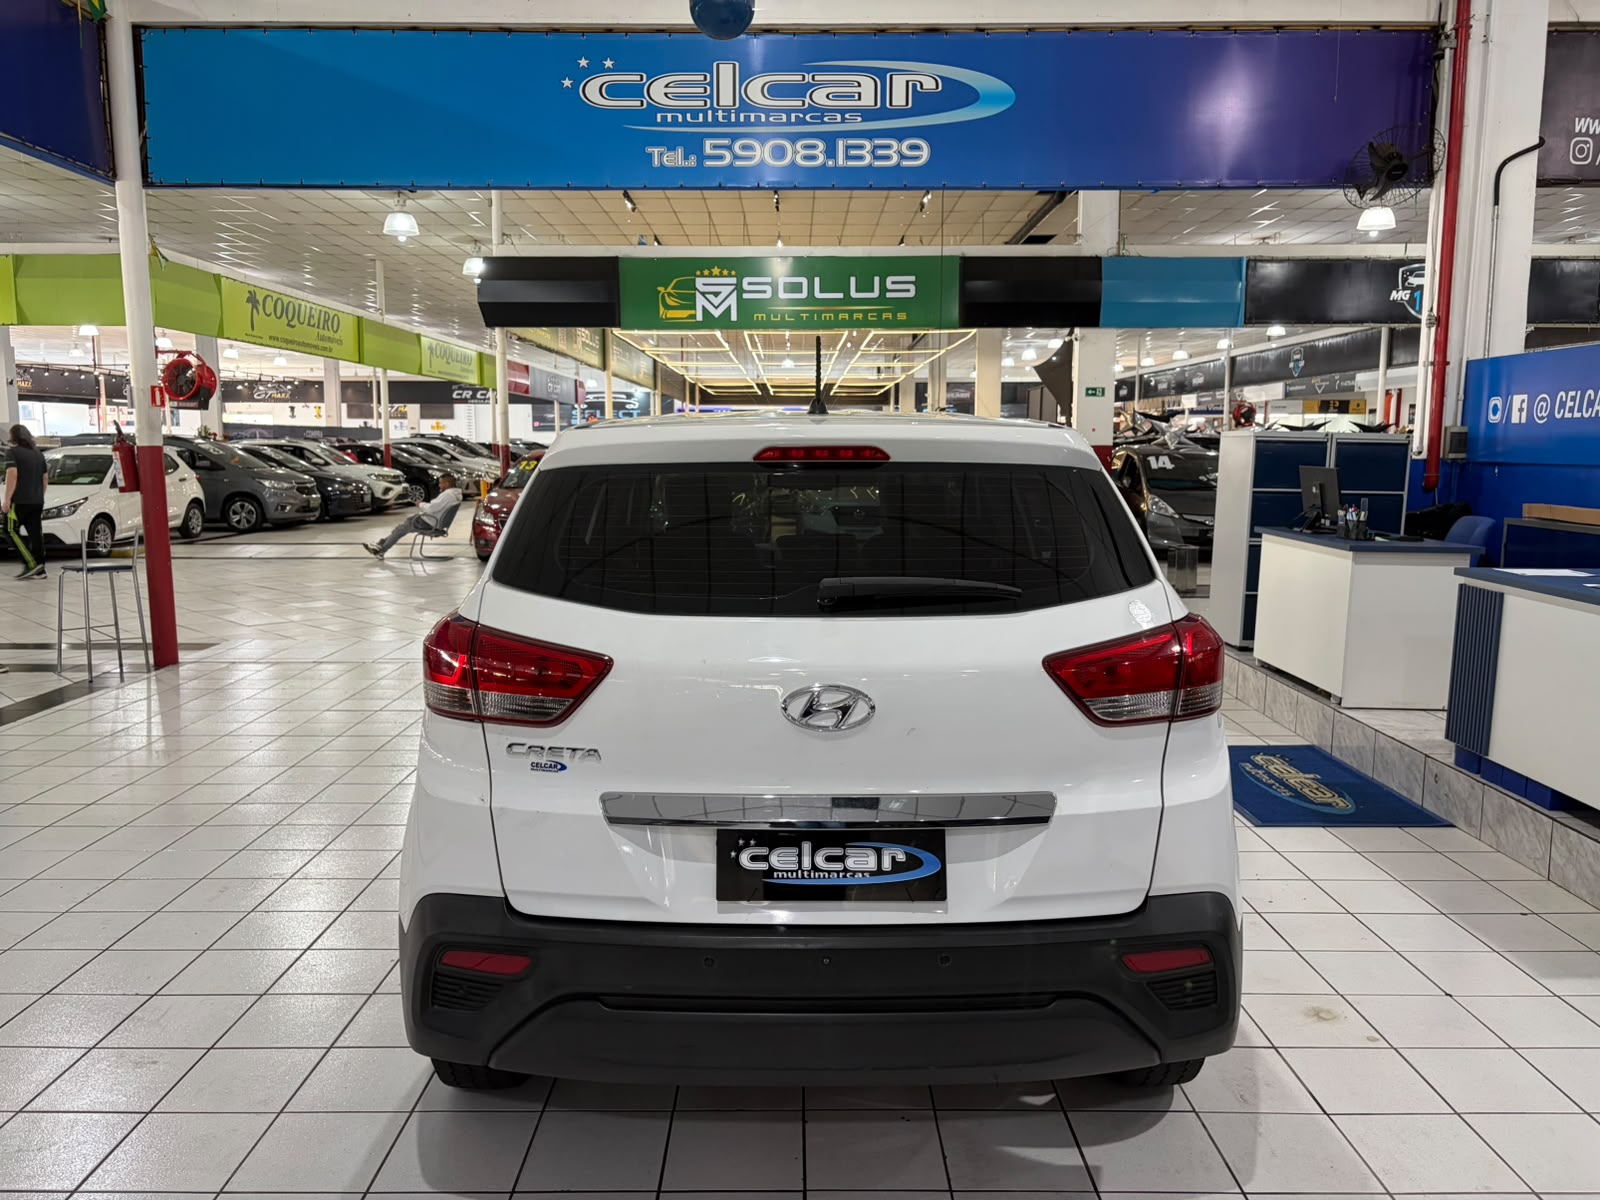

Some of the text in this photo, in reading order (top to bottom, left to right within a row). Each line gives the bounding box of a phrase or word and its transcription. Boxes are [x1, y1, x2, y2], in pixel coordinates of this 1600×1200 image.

[579, 62, 943, 109] celcar
[656, 109, 863, 123] multimarcas
[703, 137, 931, 168] 5908.1339
[742, 275, 916, 299] SOLUS
[1390, 290, 1411, 301] MG
[262, 294, 341, 334] COQUEIRO
[754, 312, 908, 321] MULTIMARCAS
[434, 342, 473, 366] COQUEIRO
[452, 390, 473, 399] CR
[519, 461, 538, 470] 13
[1146, 455, 1175, 470] 14
[506, 743, 602, 761] CRETA
[738, 841, 907, 871] celcar
[773, 869, 871, 879] multimarcas
